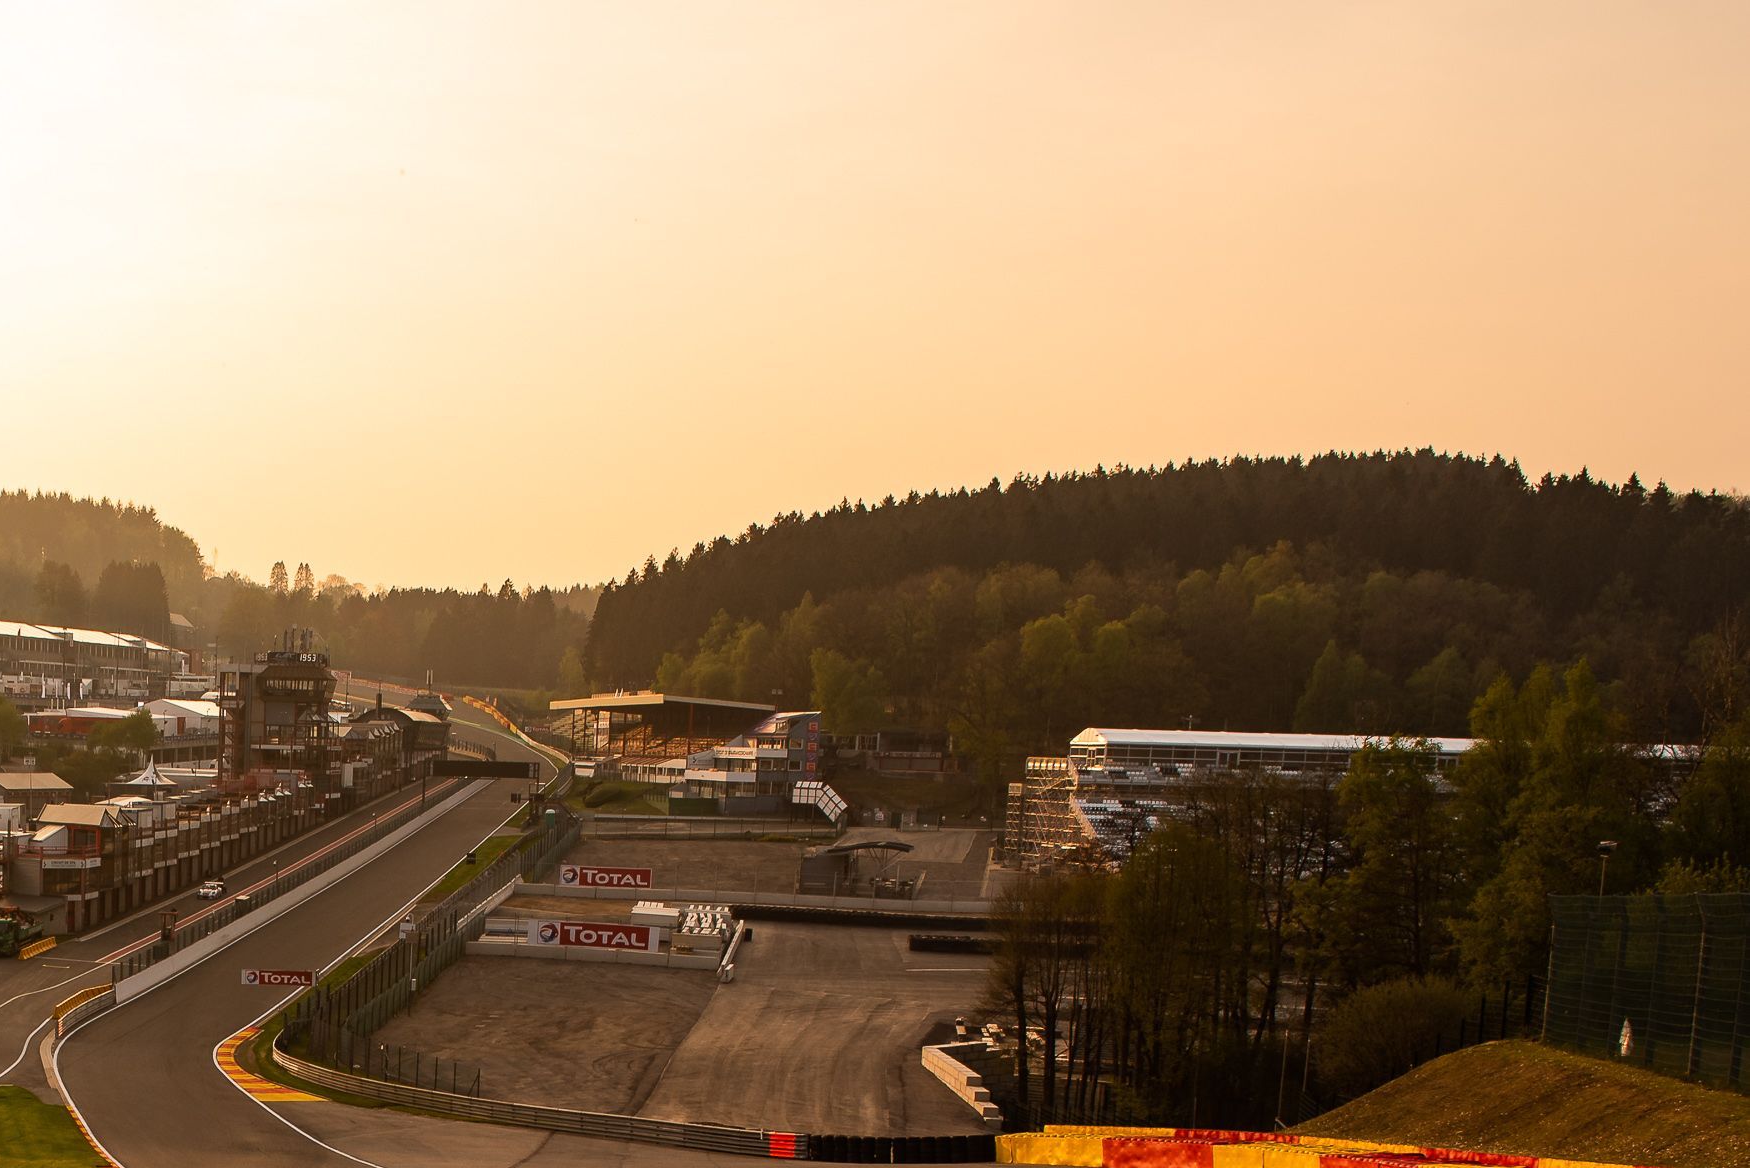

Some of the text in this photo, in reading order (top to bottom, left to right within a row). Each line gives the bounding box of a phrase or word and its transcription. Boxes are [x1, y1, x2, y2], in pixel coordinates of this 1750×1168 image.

[299, 653, 317, 662] 1953
[582, 869, 648, 886] TOTAL
[563, 925, 646, 947] TOTAL
[260, 972, 311, 984] TOTAL
